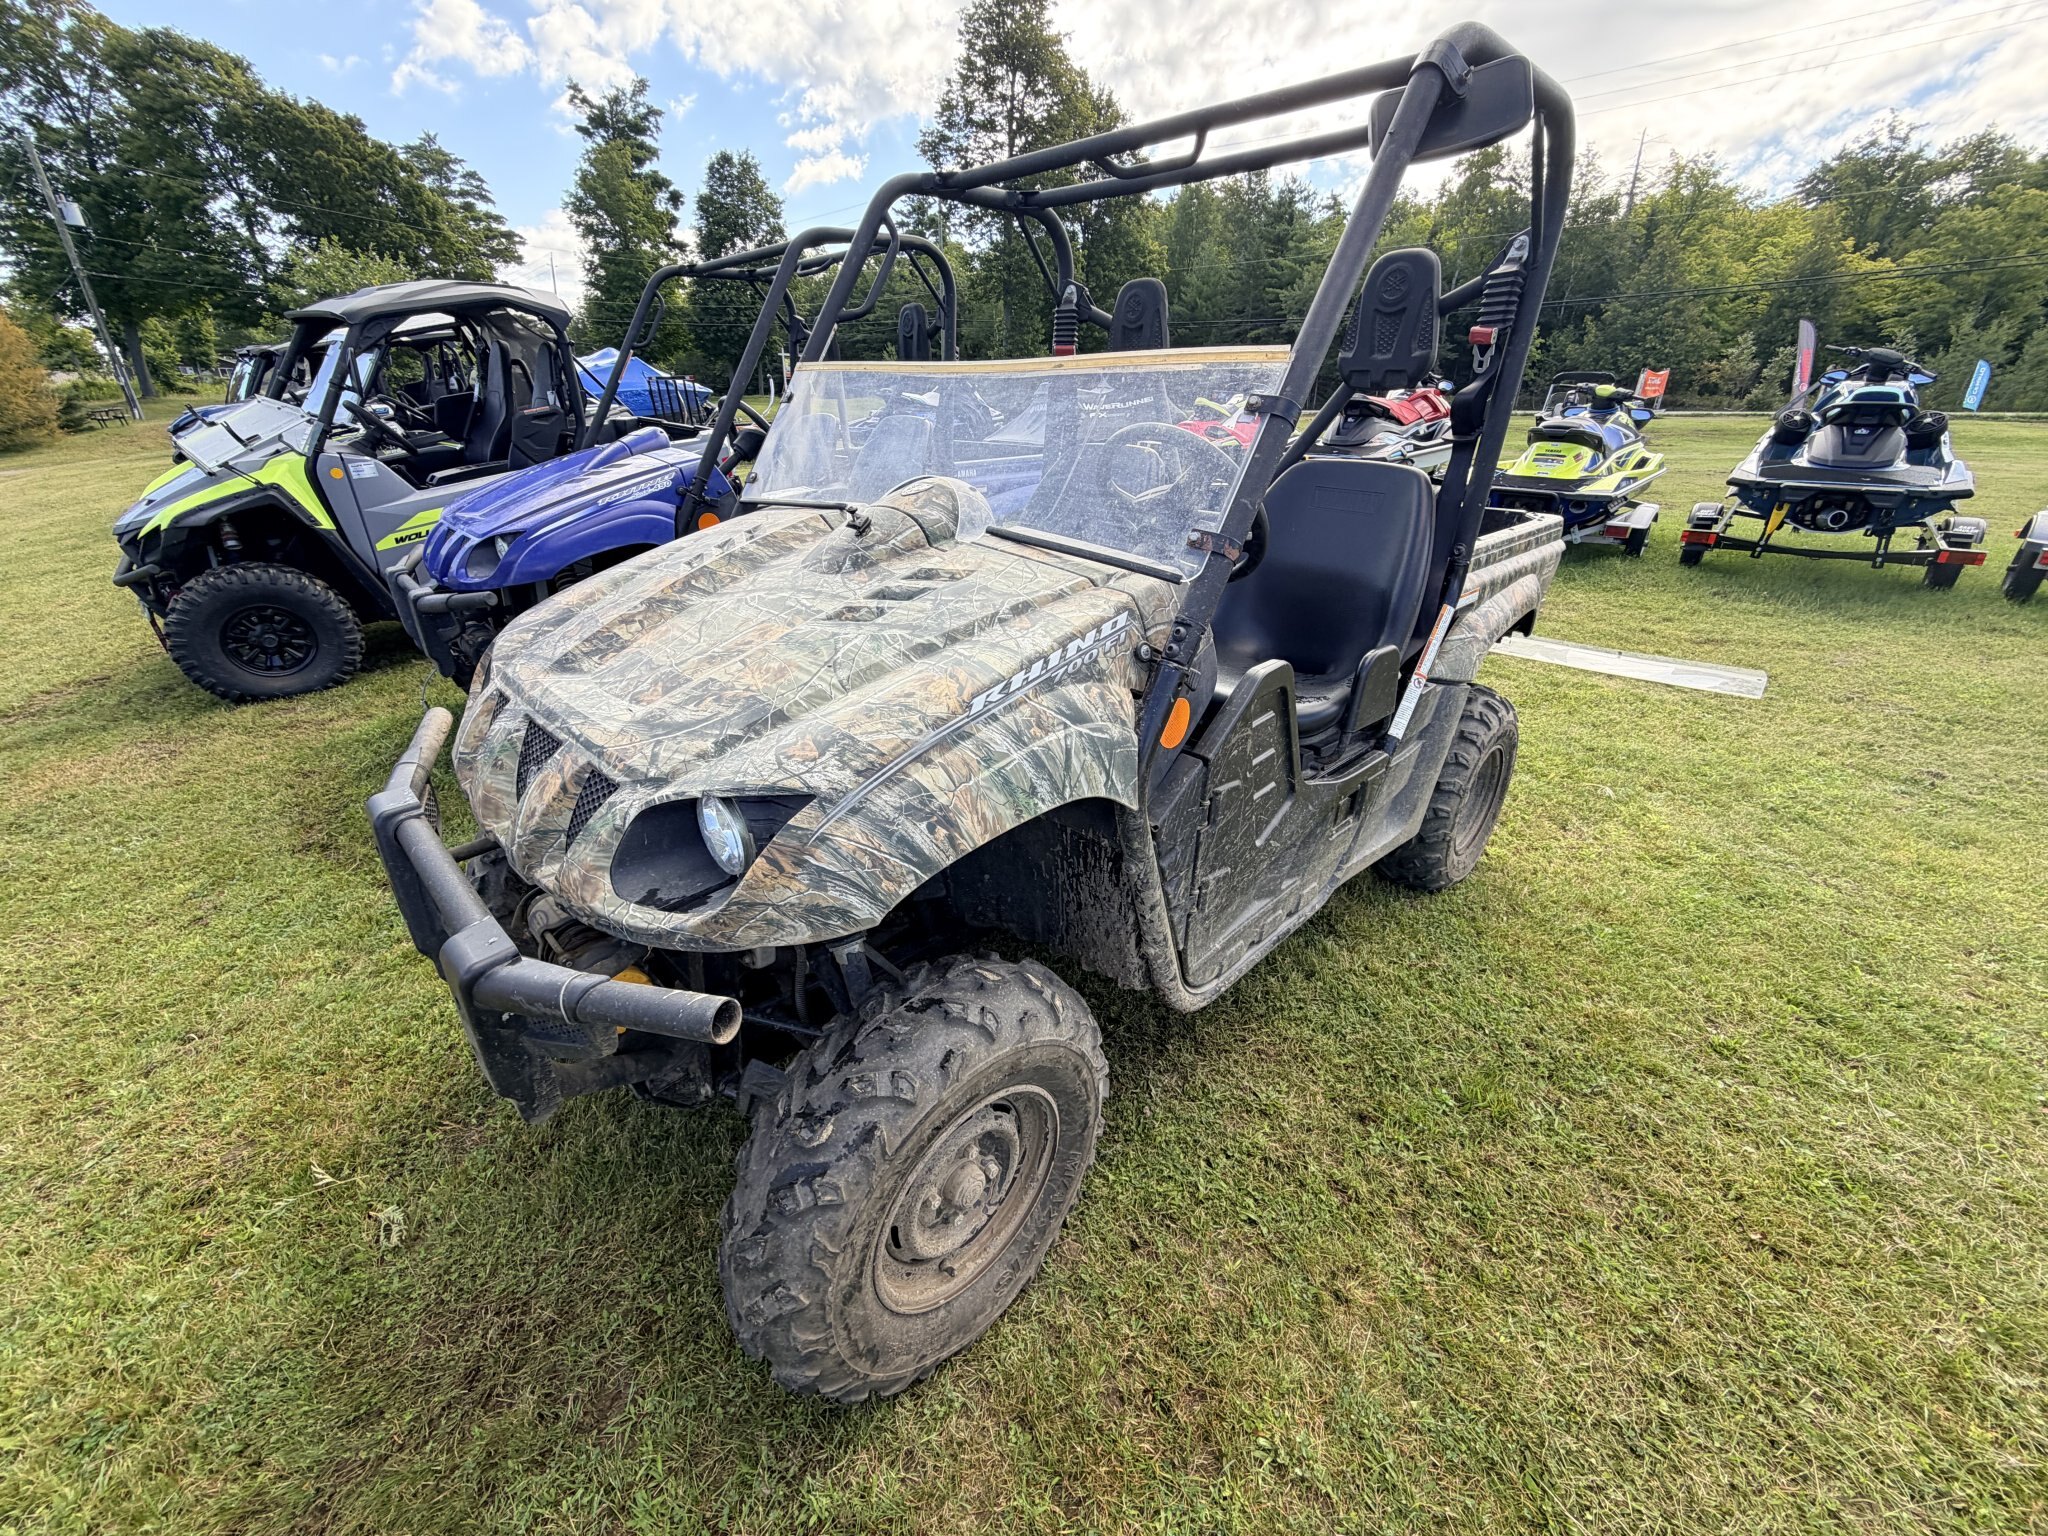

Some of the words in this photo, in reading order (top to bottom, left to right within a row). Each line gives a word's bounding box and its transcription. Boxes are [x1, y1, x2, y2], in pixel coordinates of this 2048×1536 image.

[967, 611, 1130, 717] RHINO
[1050, 648, 1099, 684] 700
[1102, 632, 1127, 654] FI
